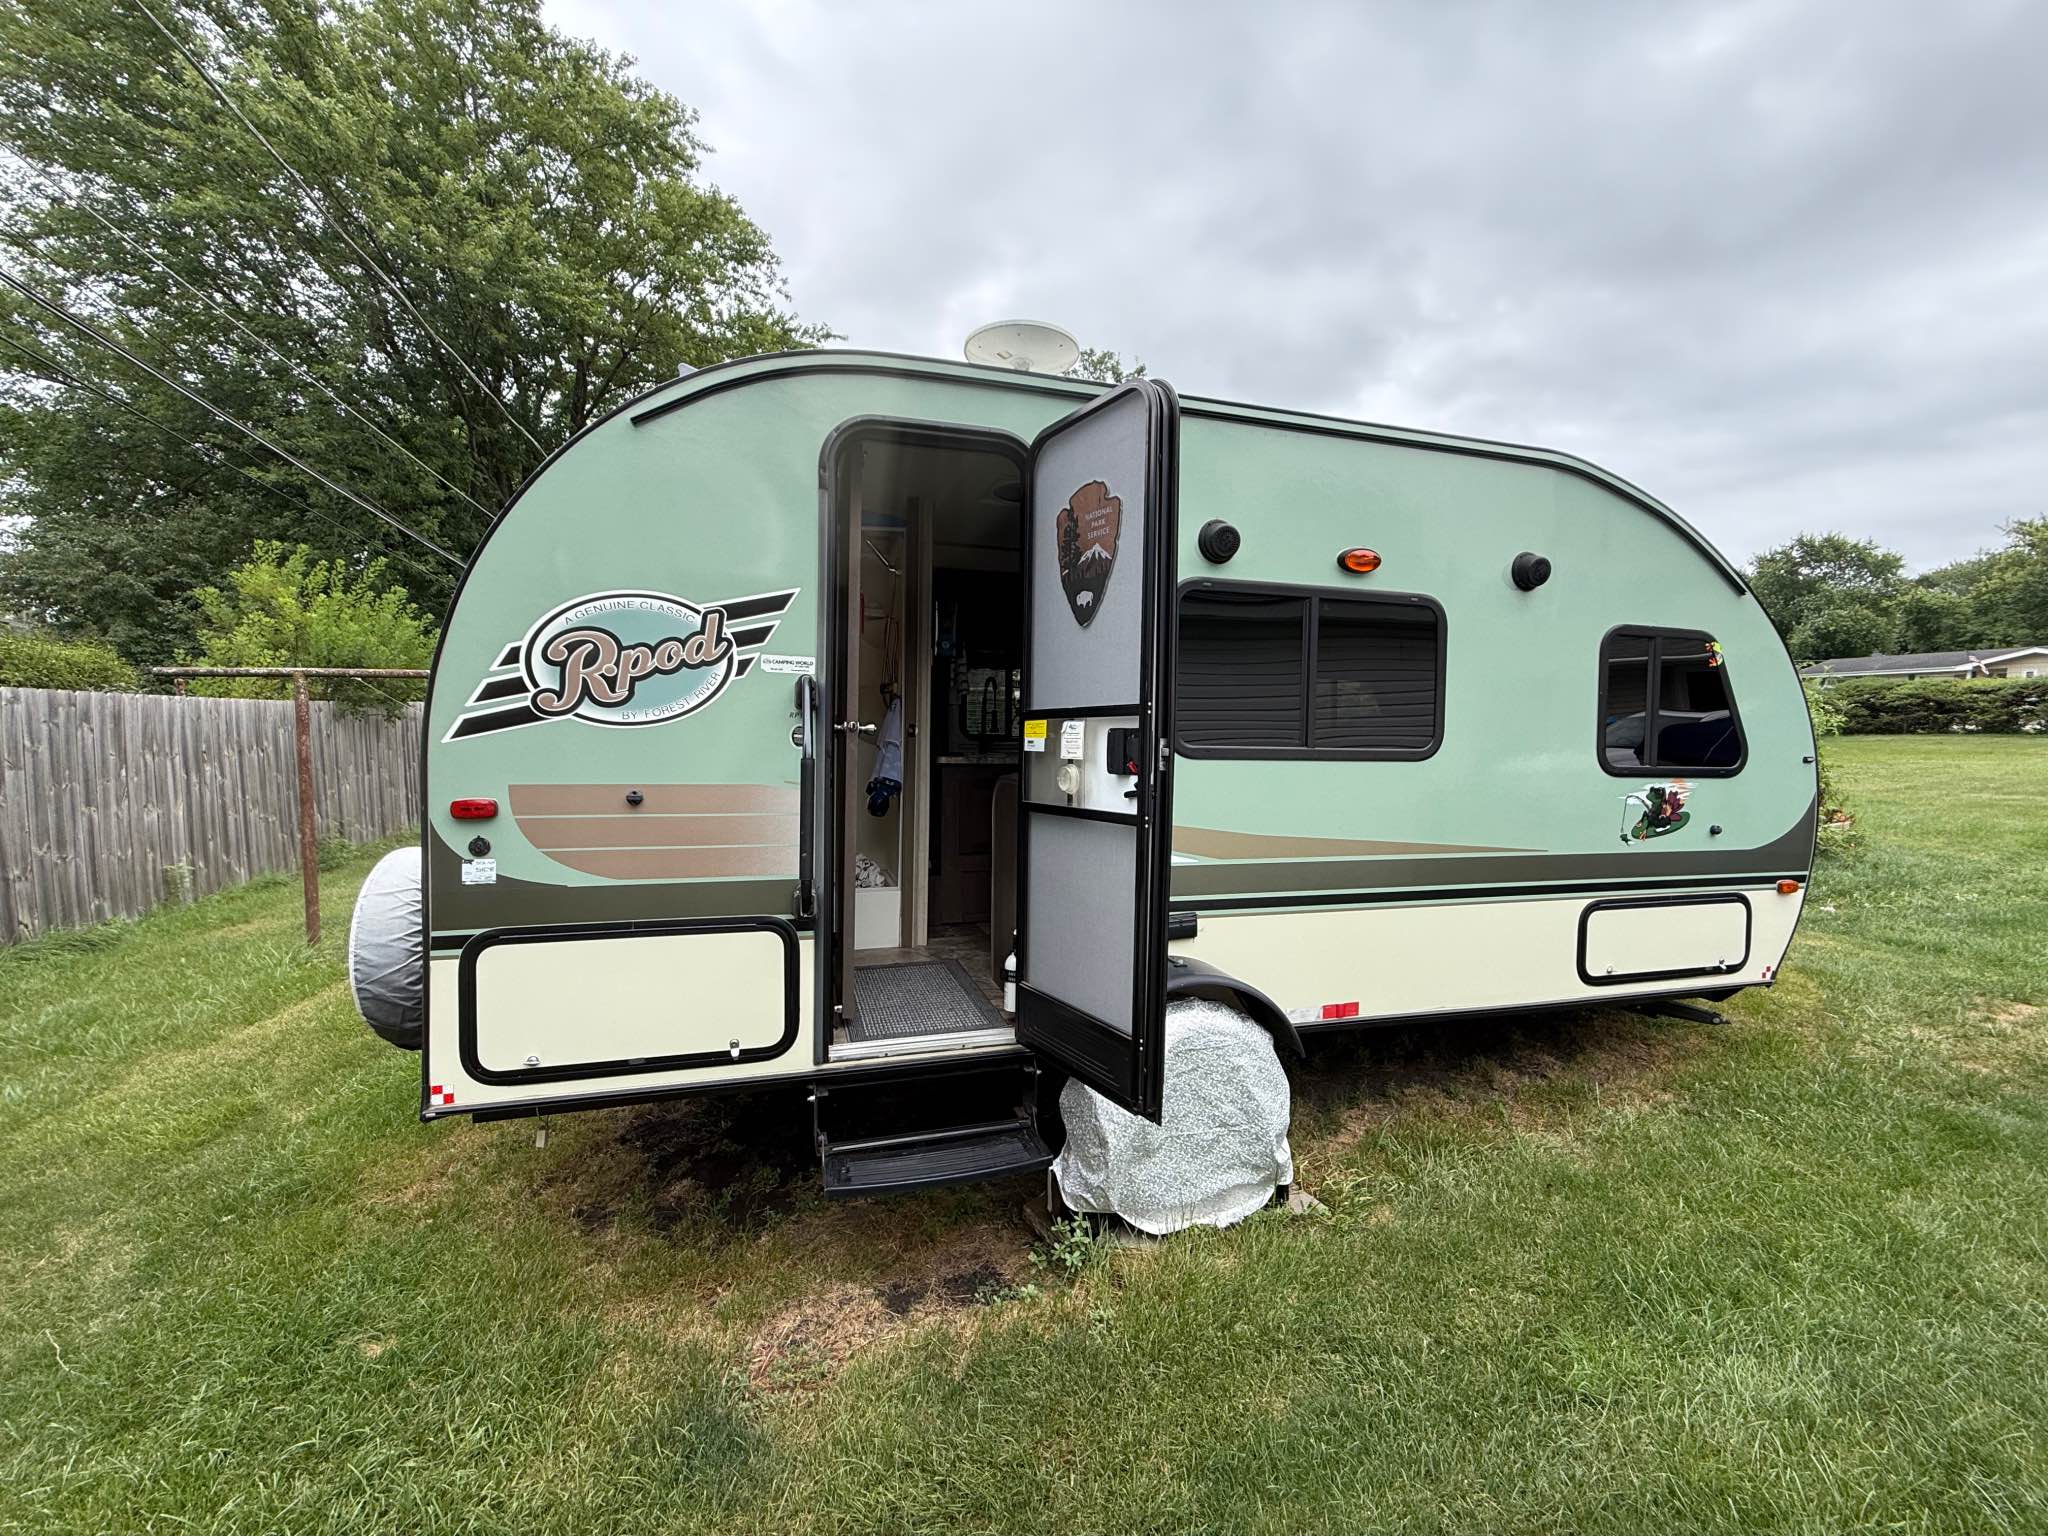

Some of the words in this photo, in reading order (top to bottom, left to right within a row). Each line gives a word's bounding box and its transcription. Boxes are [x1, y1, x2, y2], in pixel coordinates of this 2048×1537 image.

[1085, 506, 1113, 520] NATIONAL
[1091, 518, 1106, 529] PARK
[1087, 526, 1110, 540] SERVICE
[564, 616, 573, 625] A
[574, 600, 636, 619] GENUINE
[639, 601, 696, 624] CLASSIC
[772, 658, 795, 666] CAMPING
[621, 711, 638, 720] BY
[644, 697, 691, 719] FOREST
[693, 671, 721, 699] RIVER
